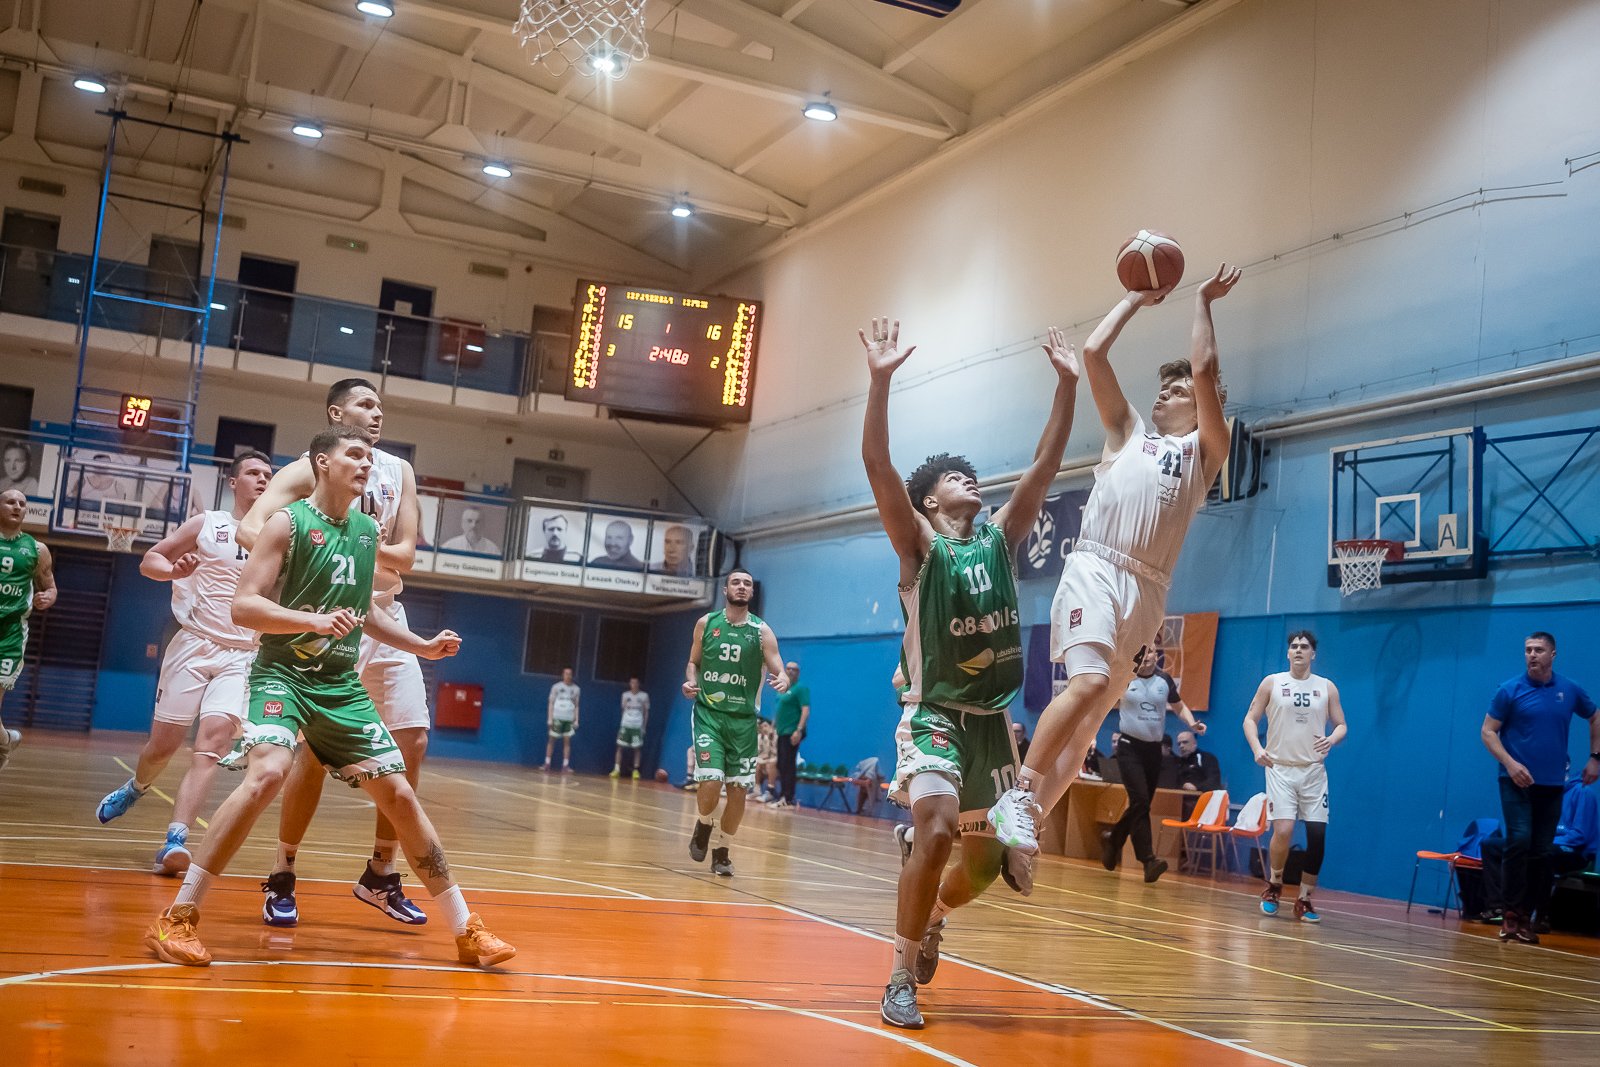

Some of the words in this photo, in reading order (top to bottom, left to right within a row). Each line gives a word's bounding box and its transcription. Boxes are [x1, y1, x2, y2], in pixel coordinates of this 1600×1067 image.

[618, 314, 634, 330] 15
[706, 325, 722, 341] 16
[606, 343, 616, 357] 3
[709, 356, 720, 369] 2
[122, 408, 147, 427] 20
[1158, 450, 1182, 478] 41
[1440, 522, 1455, 547] A
[1, 556, 14, 574] 9
[331, 553, 357, 586] 21
[963, 562, 993, 595] 10
[950, 616, 977, 637] Q8
[718, 643, 741, 663] 33
[0, 658, 13, 675] 9
[703, 670, 719, 682] Q8
[1293, 692, 1311, 708] 35
[991, 764, 1015, 799] 10
